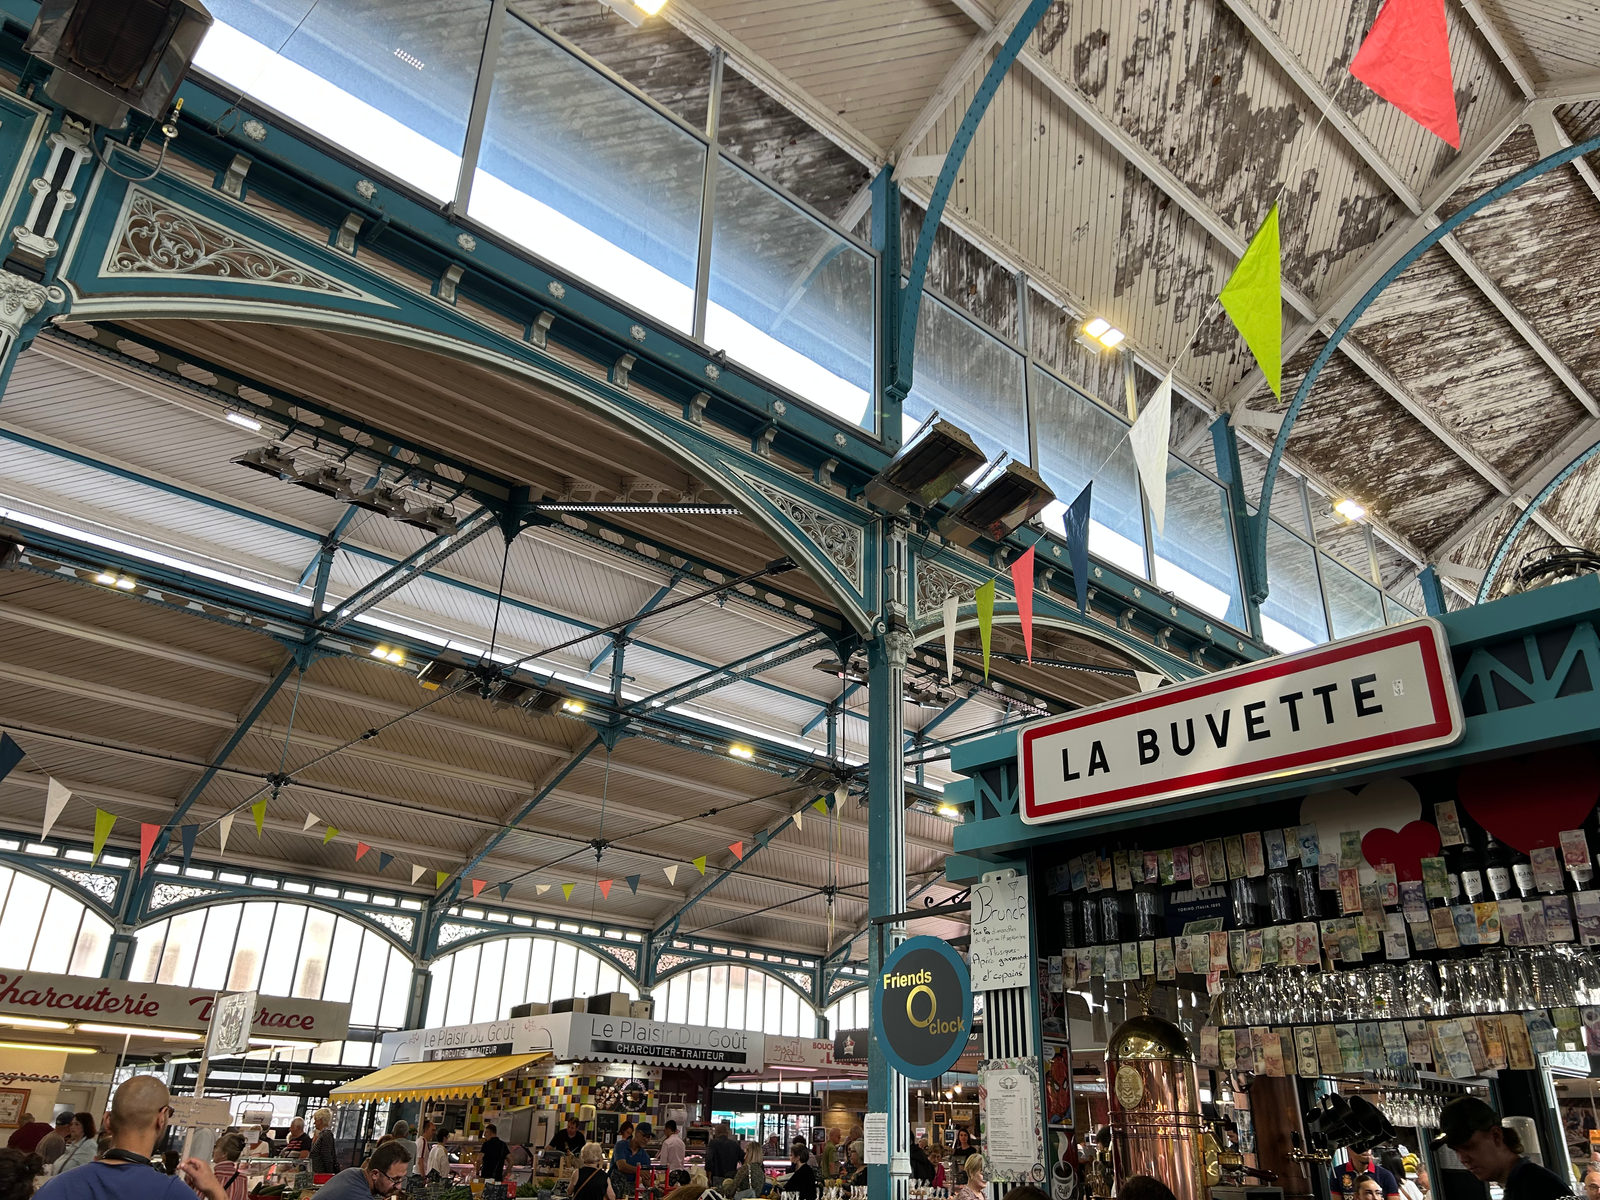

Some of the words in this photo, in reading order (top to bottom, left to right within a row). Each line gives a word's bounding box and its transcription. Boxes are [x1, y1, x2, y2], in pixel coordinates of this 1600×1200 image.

[1062, 740, 1111, 782] LA
[1137, 673, 1384, 766] BUVETTE
[974, 885, 1027, 925] Brunch
[1170, 885, 1227, 904] LAVAZZA
[883, 968, 932, 989] Friends
[424, 1031, 436, 1048] Le
[437, 1028, 469, 1046] Plaisir
[487, 1022, 516, 1042] Goût
[591, 1018, 613, 1037] Le
[620, 1021, 673, 1043] Plaisir
[679, 1027, 702, 1046] Du
[708, 1030, 748, 1050] Goût
[929, 1016, 965, 1035] clock
[616, 1043, 725, 1061] CHARCUTIER-TRAITEUR
